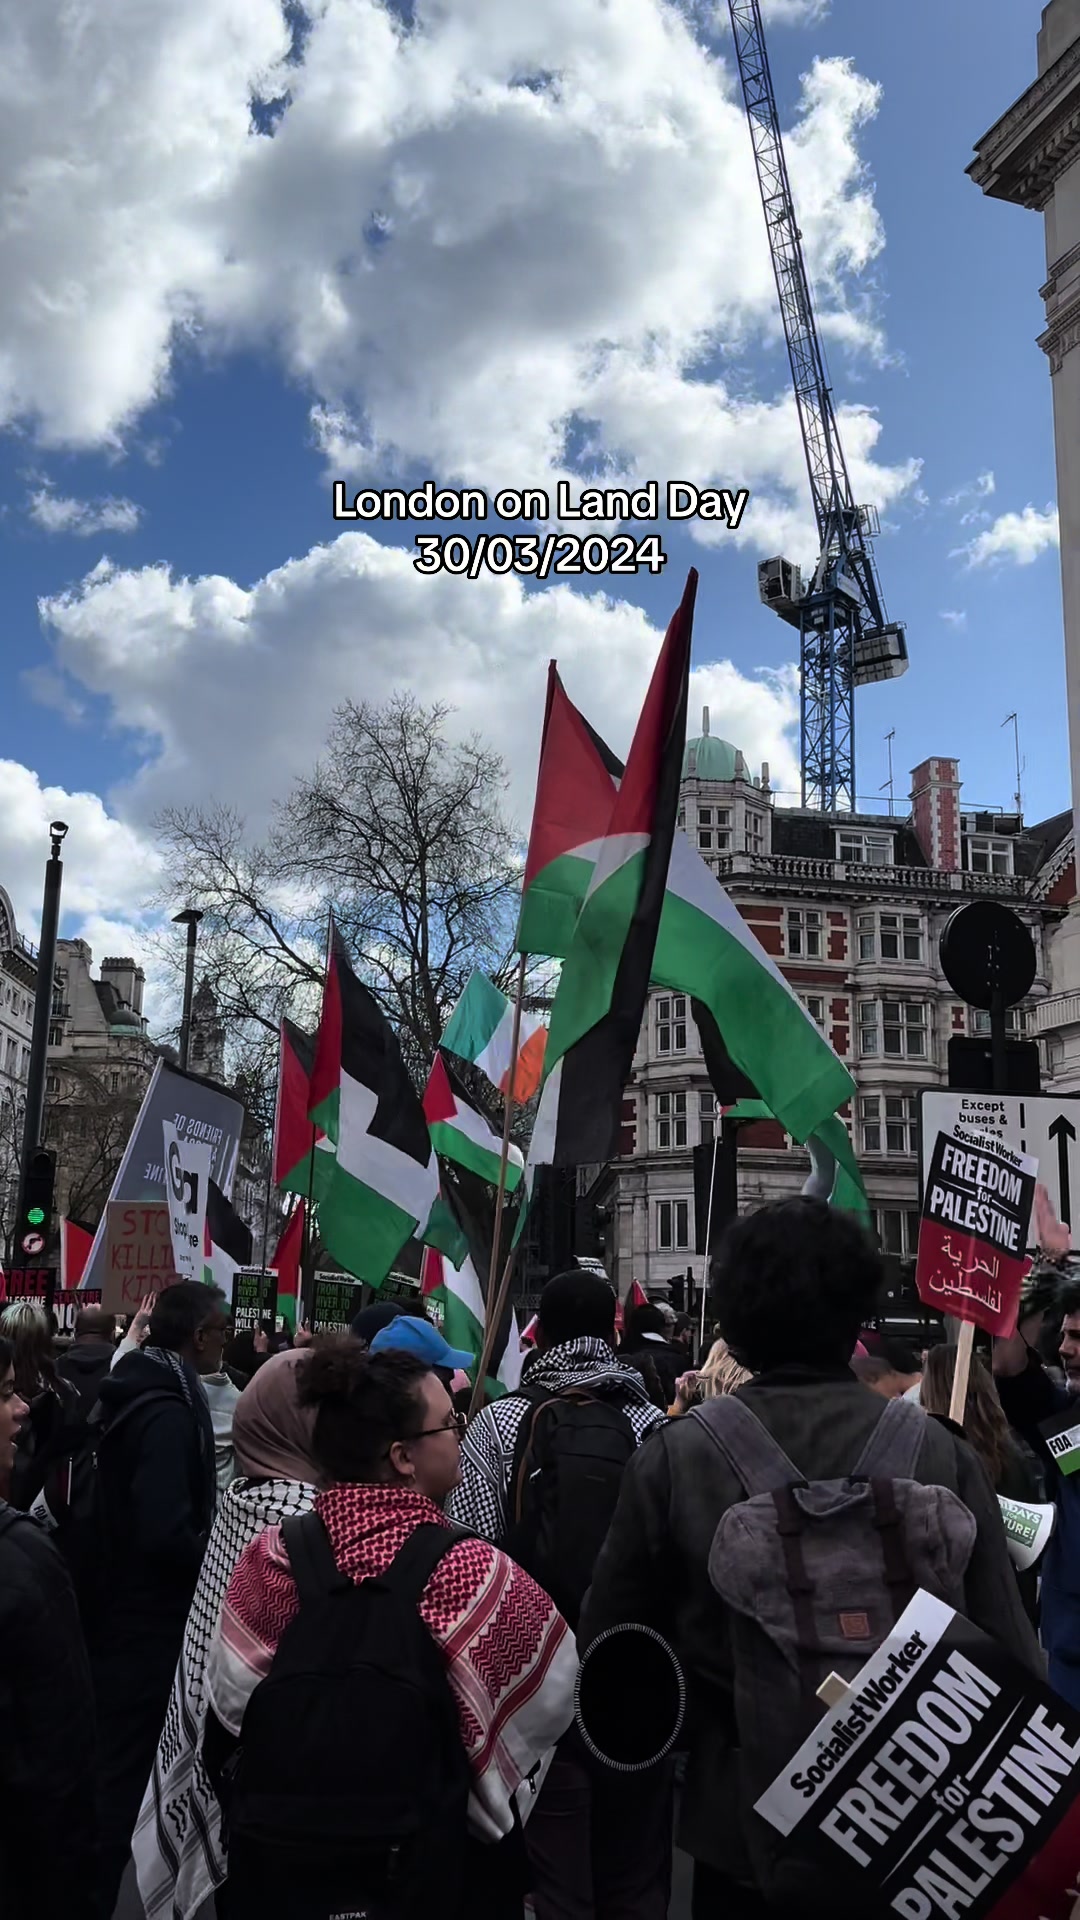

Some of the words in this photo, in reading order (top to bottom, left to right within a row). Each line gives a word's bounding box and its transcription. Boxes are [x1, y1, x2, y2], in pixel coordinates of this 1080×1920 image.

[959, 1112, 995, 1125] buses
[998, 1114, 1008, 1125] &
[961, 1099, 1005, 1112] Except
[940, 1142, 1023, 1206] FREEDOM
[976, 1186, 993, 1205] for
[122, 1209, 169, 1237] STO
[930, 1184, 1021, 1252] PALESTINE
[112, 1244, 175, 1271] KILLI
[941, 1235, 1000, 1279] الحرية
[235, 1307, 272, 1320] PALESTNE
[1048, 1434, 1073, 1455] FOA
[1000, 1500, 1042, 1524] IDAYS
[1002, 1515, 1036, 1540] TURE!
[818, 1649, 1002, 1868] FREEDOM
[931, 1774, 972, 1815] for
[890, 1703, 1080, 1920] PALESTINE
